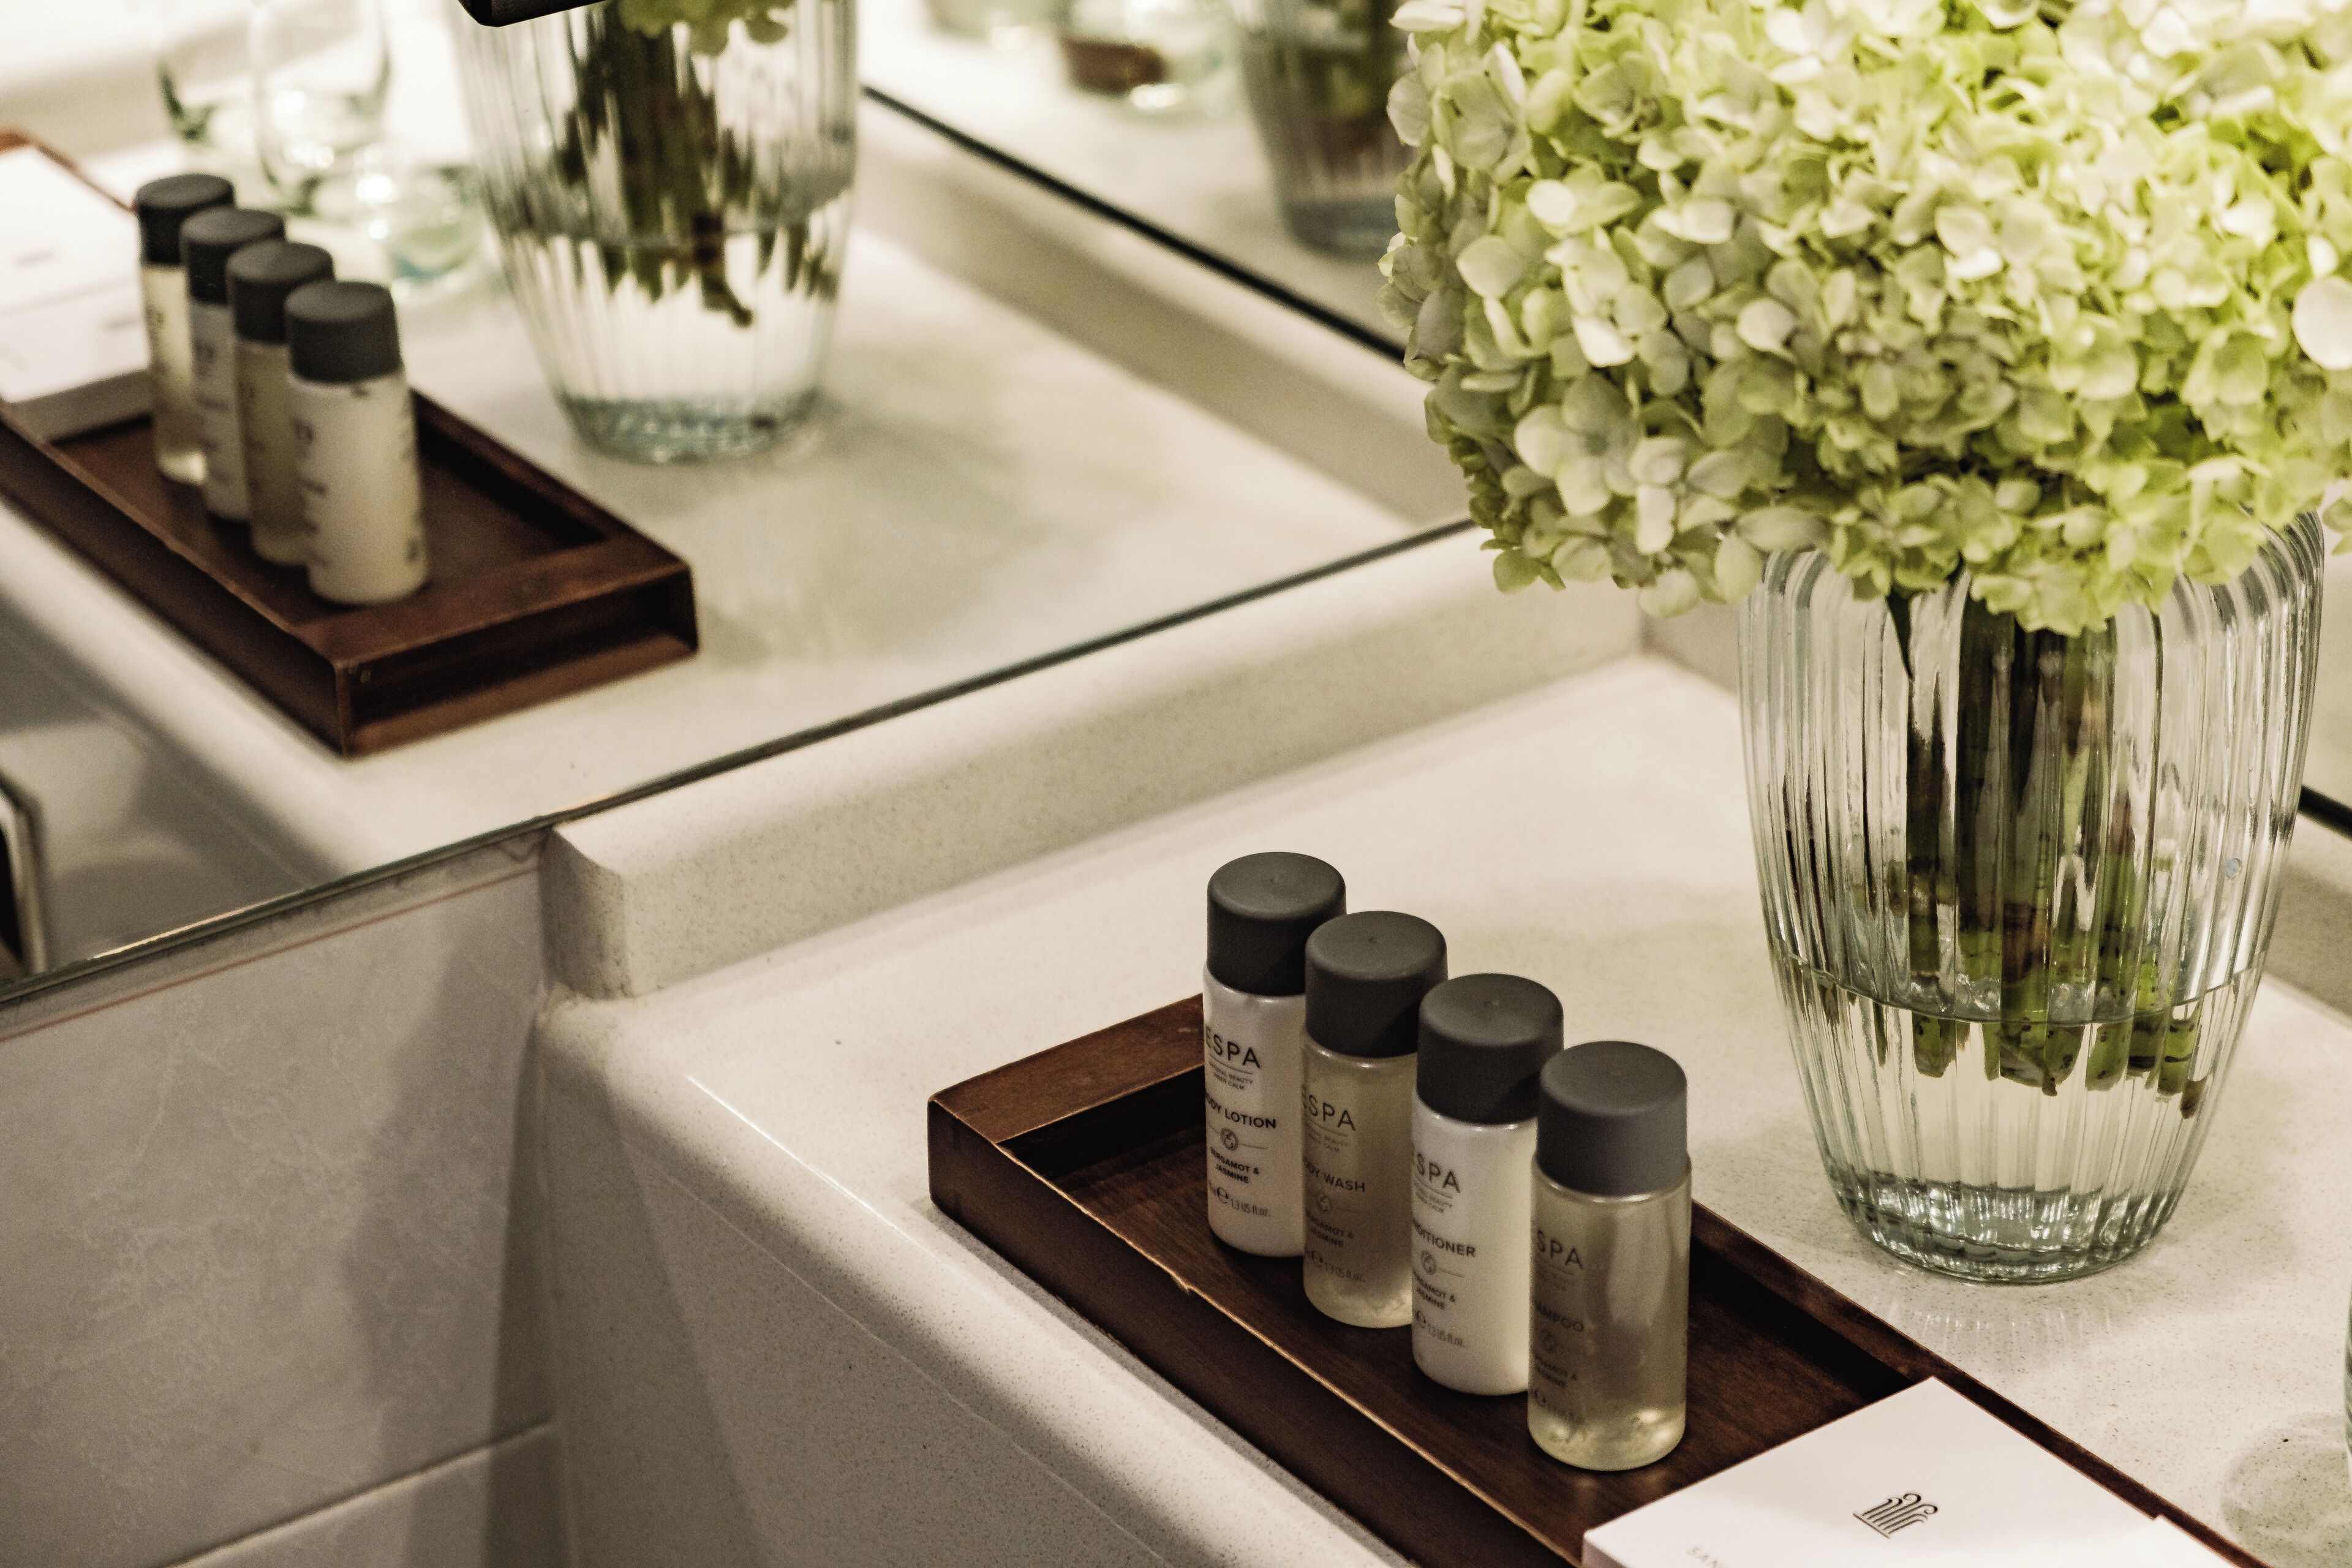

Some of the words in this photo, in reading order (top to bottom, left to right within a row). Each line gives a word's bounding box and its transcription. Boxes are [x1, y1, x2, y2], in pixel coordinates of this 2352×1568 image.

[1205, 1092, 1222, 1114] ODY
[1225, 1108, 1276, 1128] LOTION
[1253, 1167, 1259, 1175] &
[1323, 1171, 1365, 1193] WASH
[1414, 1148, 1460, 1194] SPA
[1537, 1230, 1583, 1270] SPA
